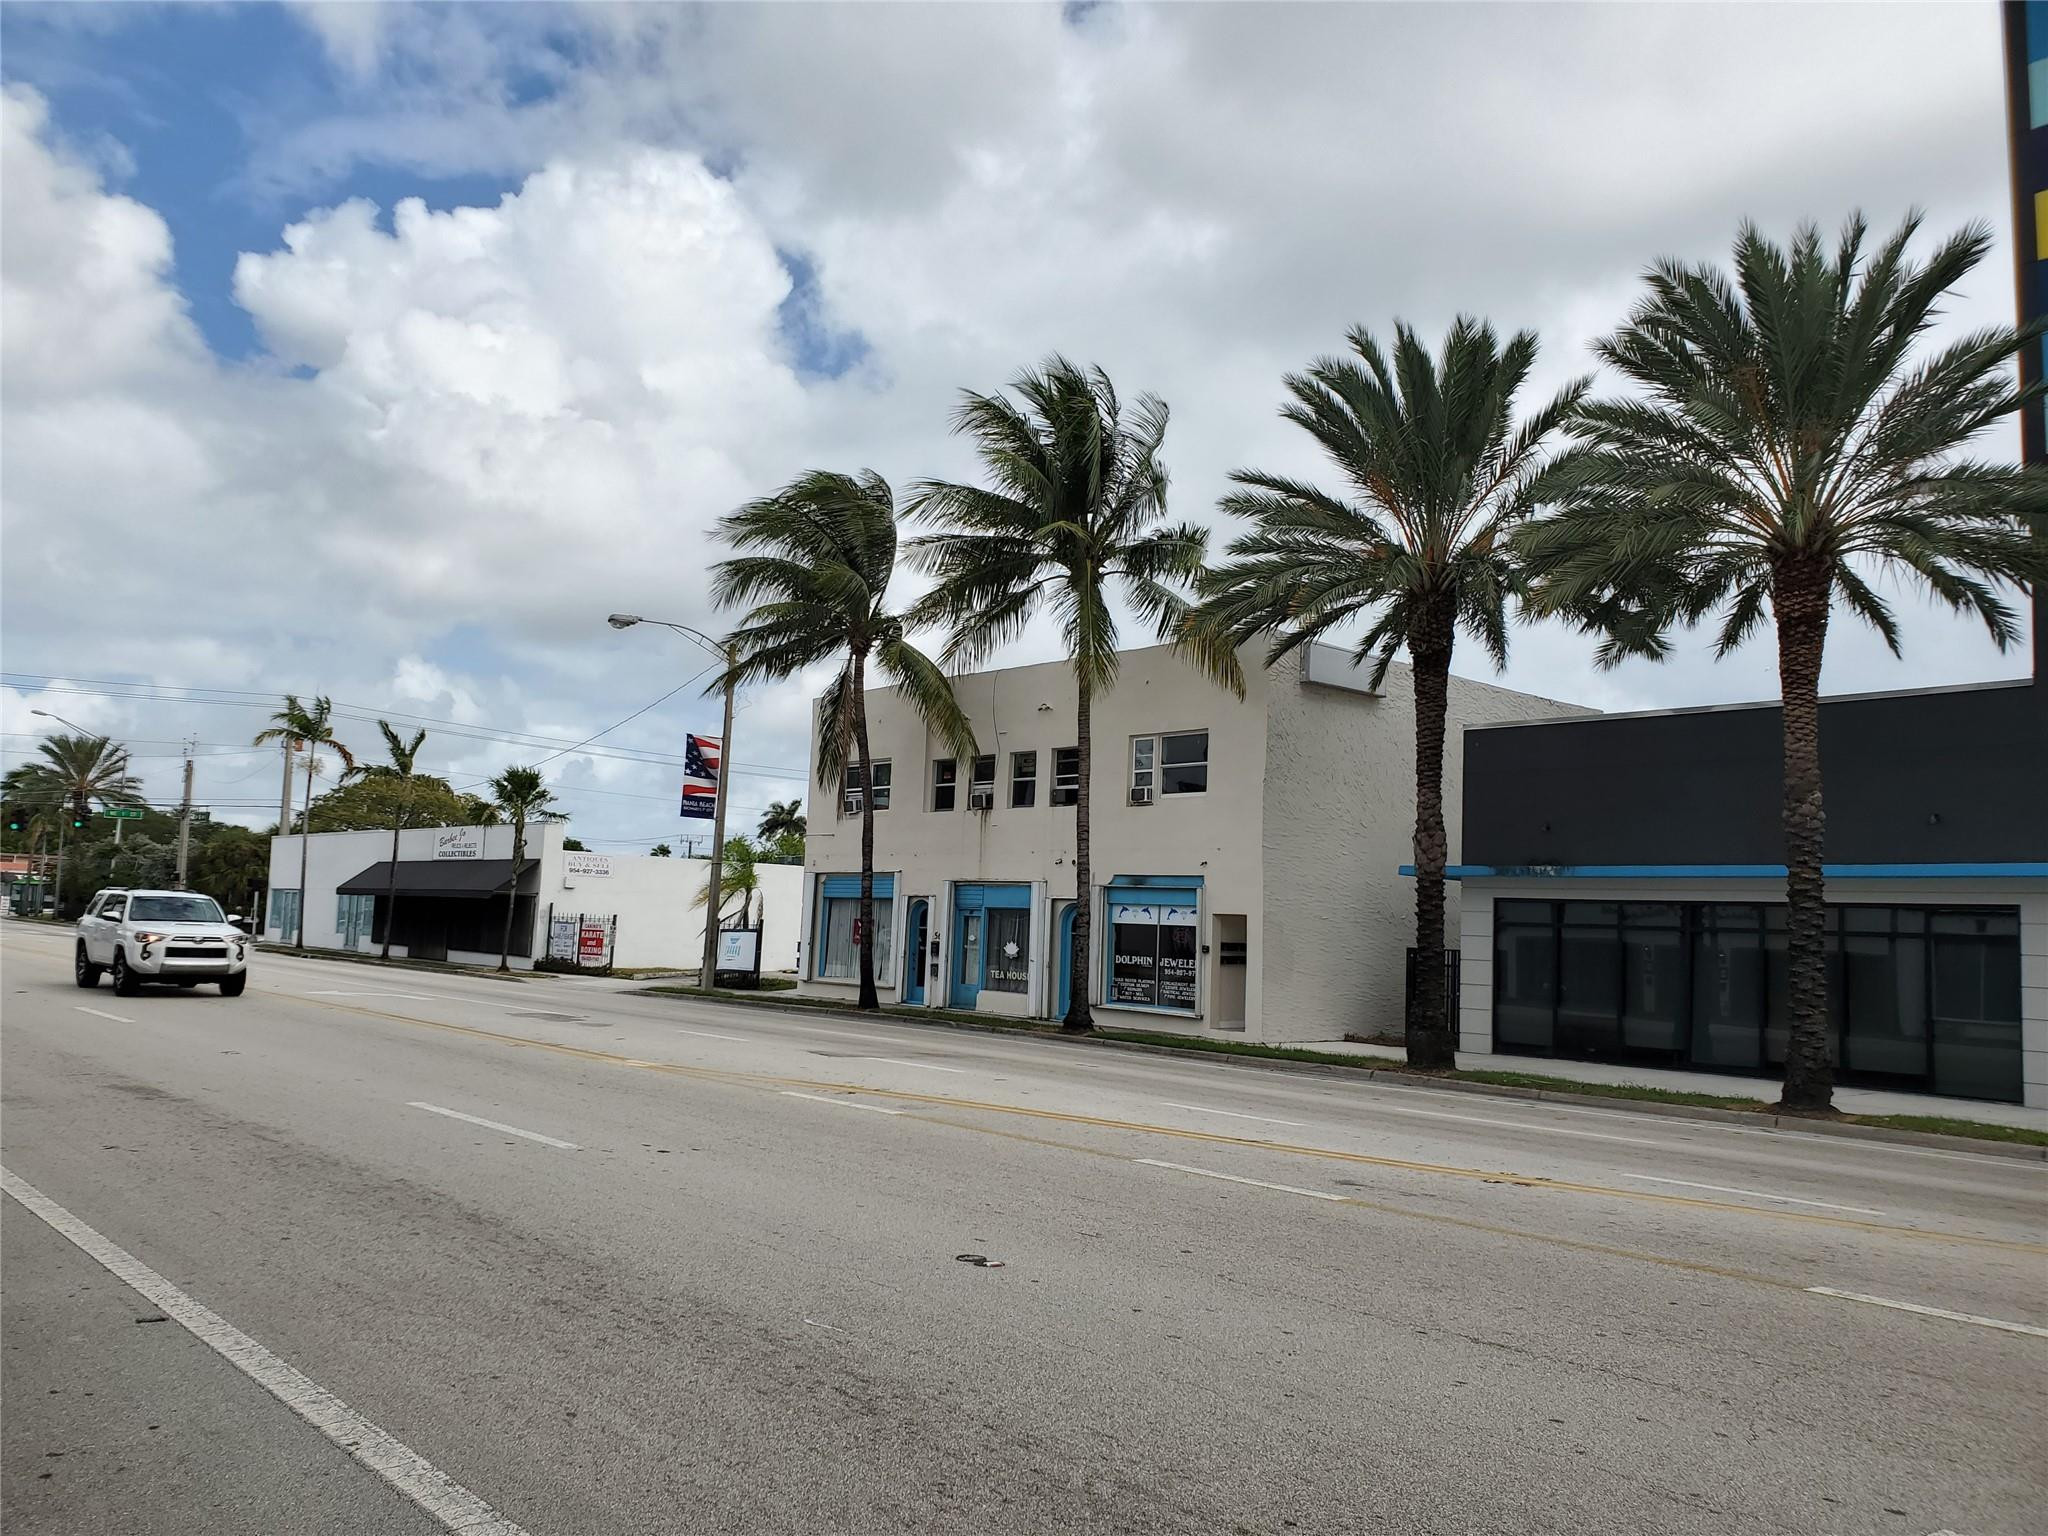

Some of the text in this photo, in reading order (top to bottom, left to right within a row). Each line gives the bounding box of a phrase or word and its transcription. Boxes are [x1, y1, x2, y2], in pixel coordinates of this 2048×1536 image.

[438, 850, 477, 858] COLLECTIBLES
[573, 855, 609, 863] ANTIQUES
[581, 930, 604, 939] KARATE
[580, 945, 602, 954] BOXING
[1115, 955, 1152, 965] DOLPHIN
[990, 970, 1005, 979] TEA
